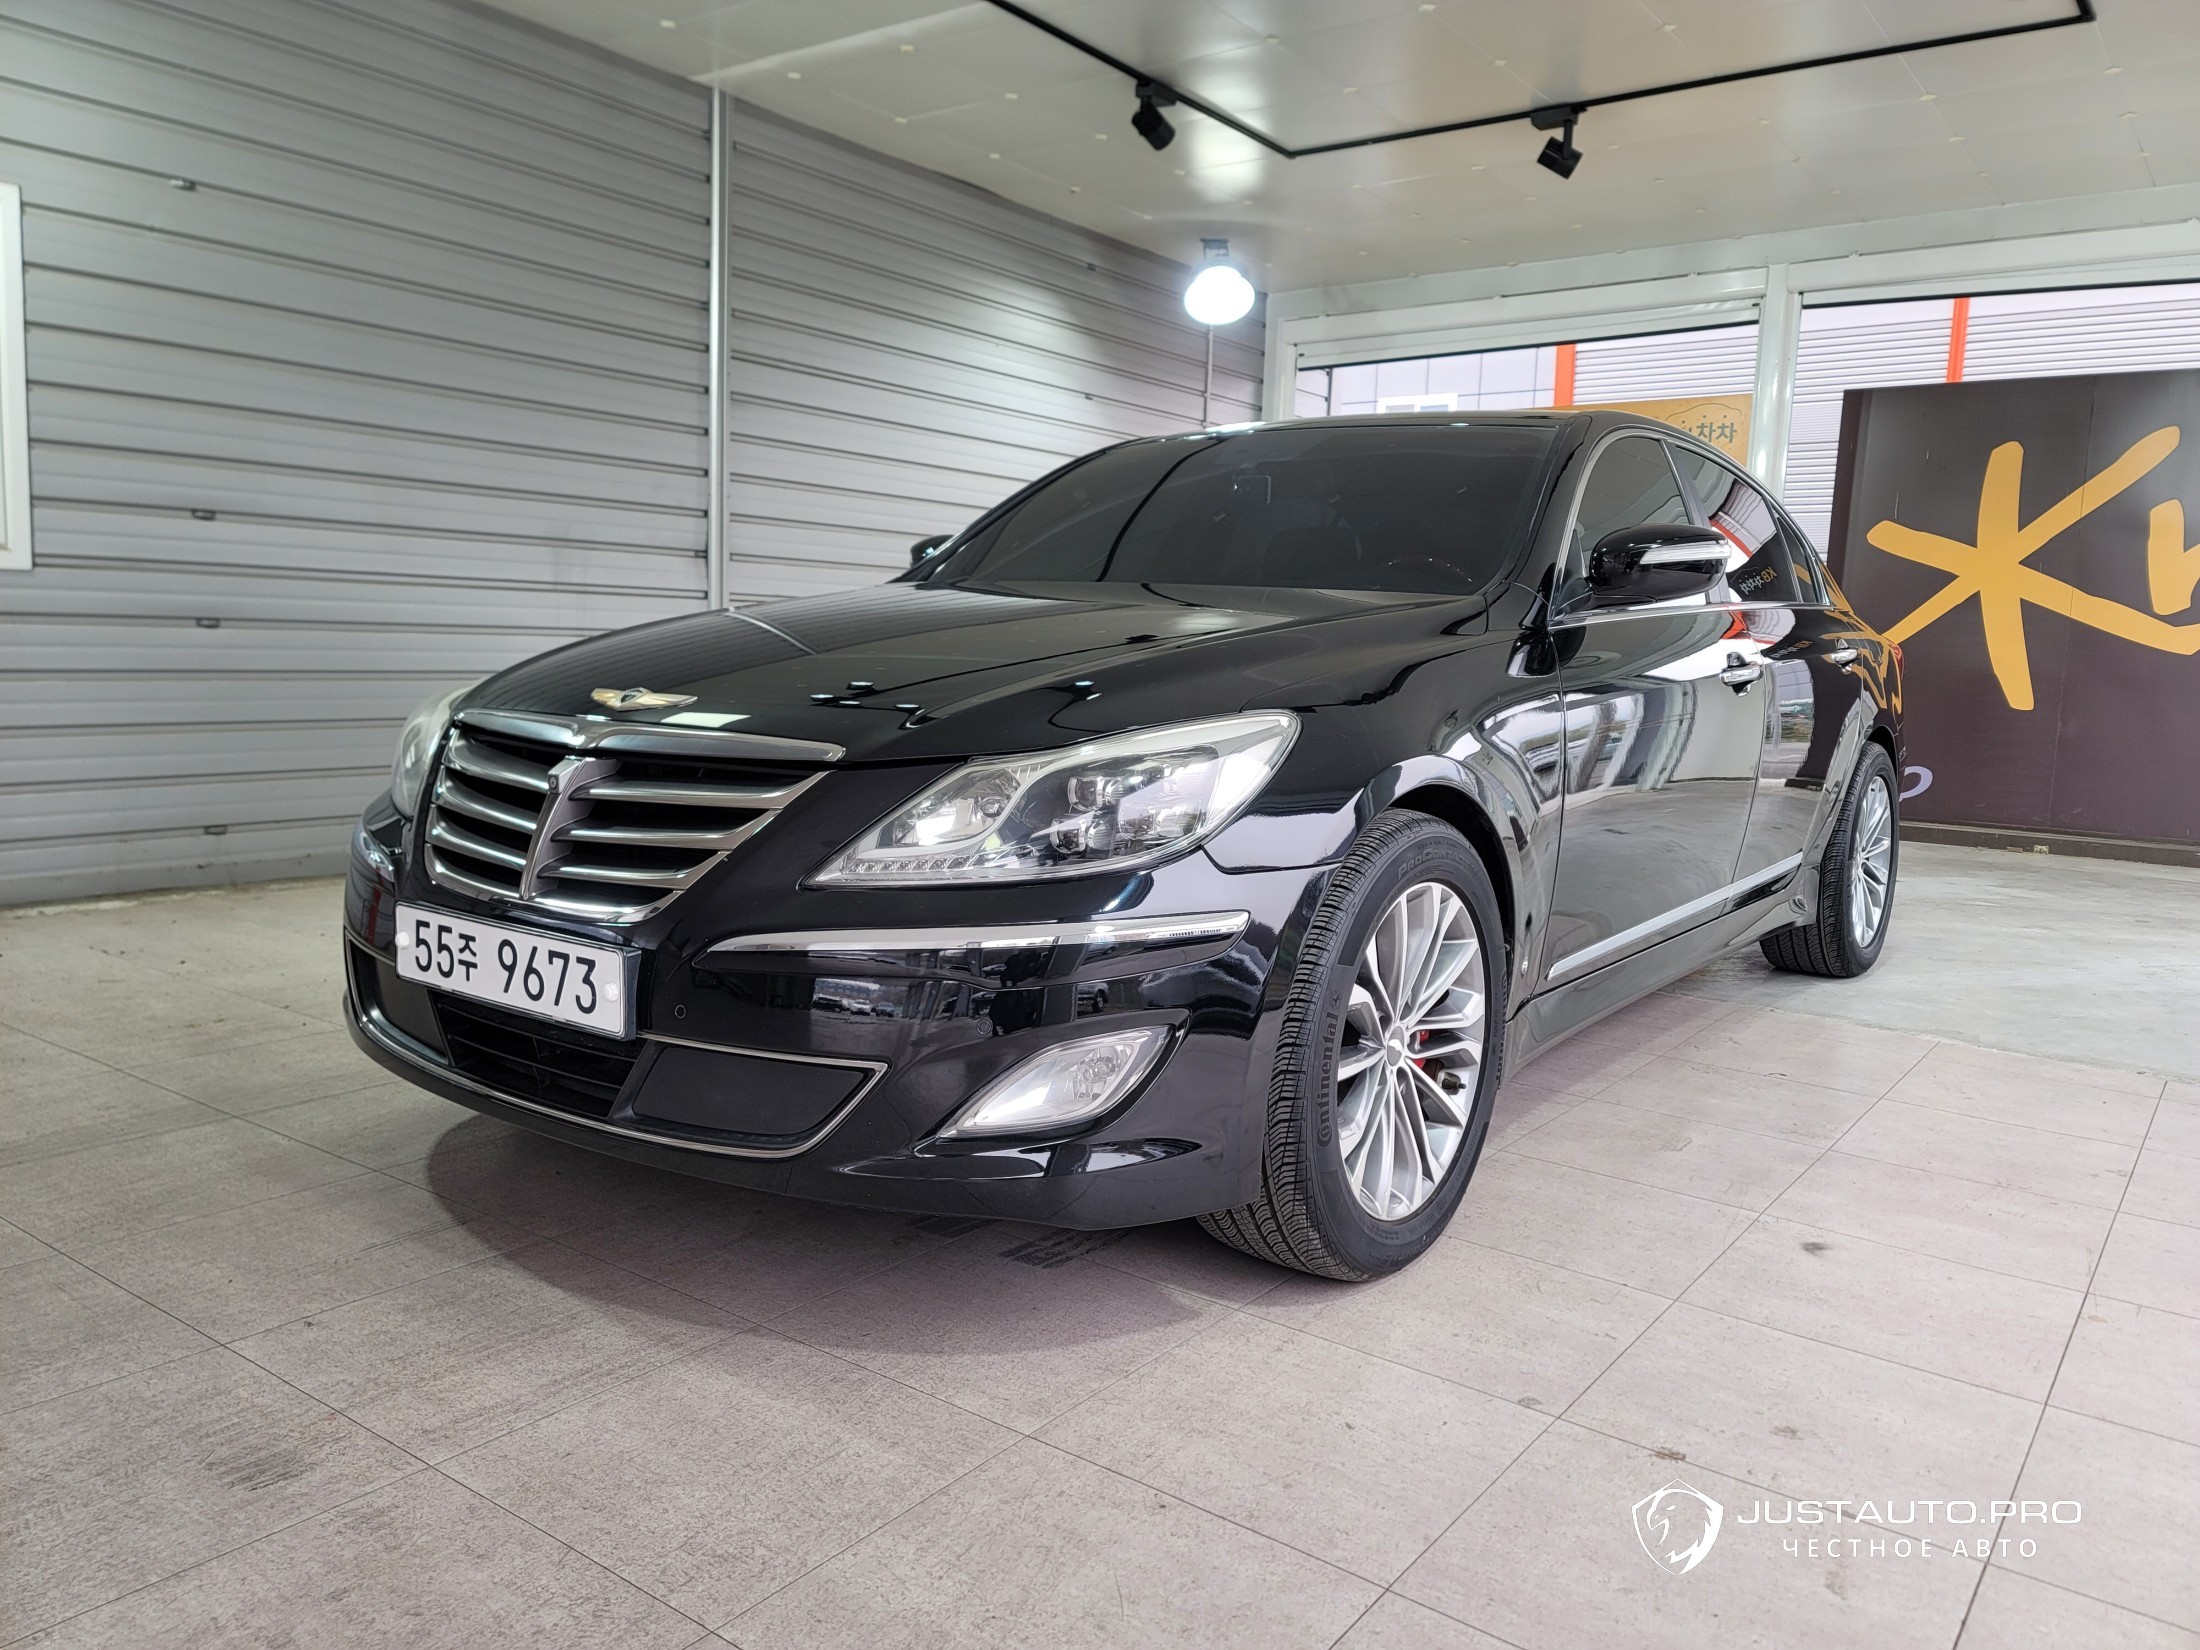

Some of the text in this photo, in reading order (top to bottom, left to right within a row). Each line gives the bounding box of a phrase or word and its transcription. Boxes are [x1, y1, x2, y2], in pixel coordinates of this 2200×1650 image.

[415, 919, 597, 1015] 55주 9673
[1316, 1011, 1340, 1148] Continental
